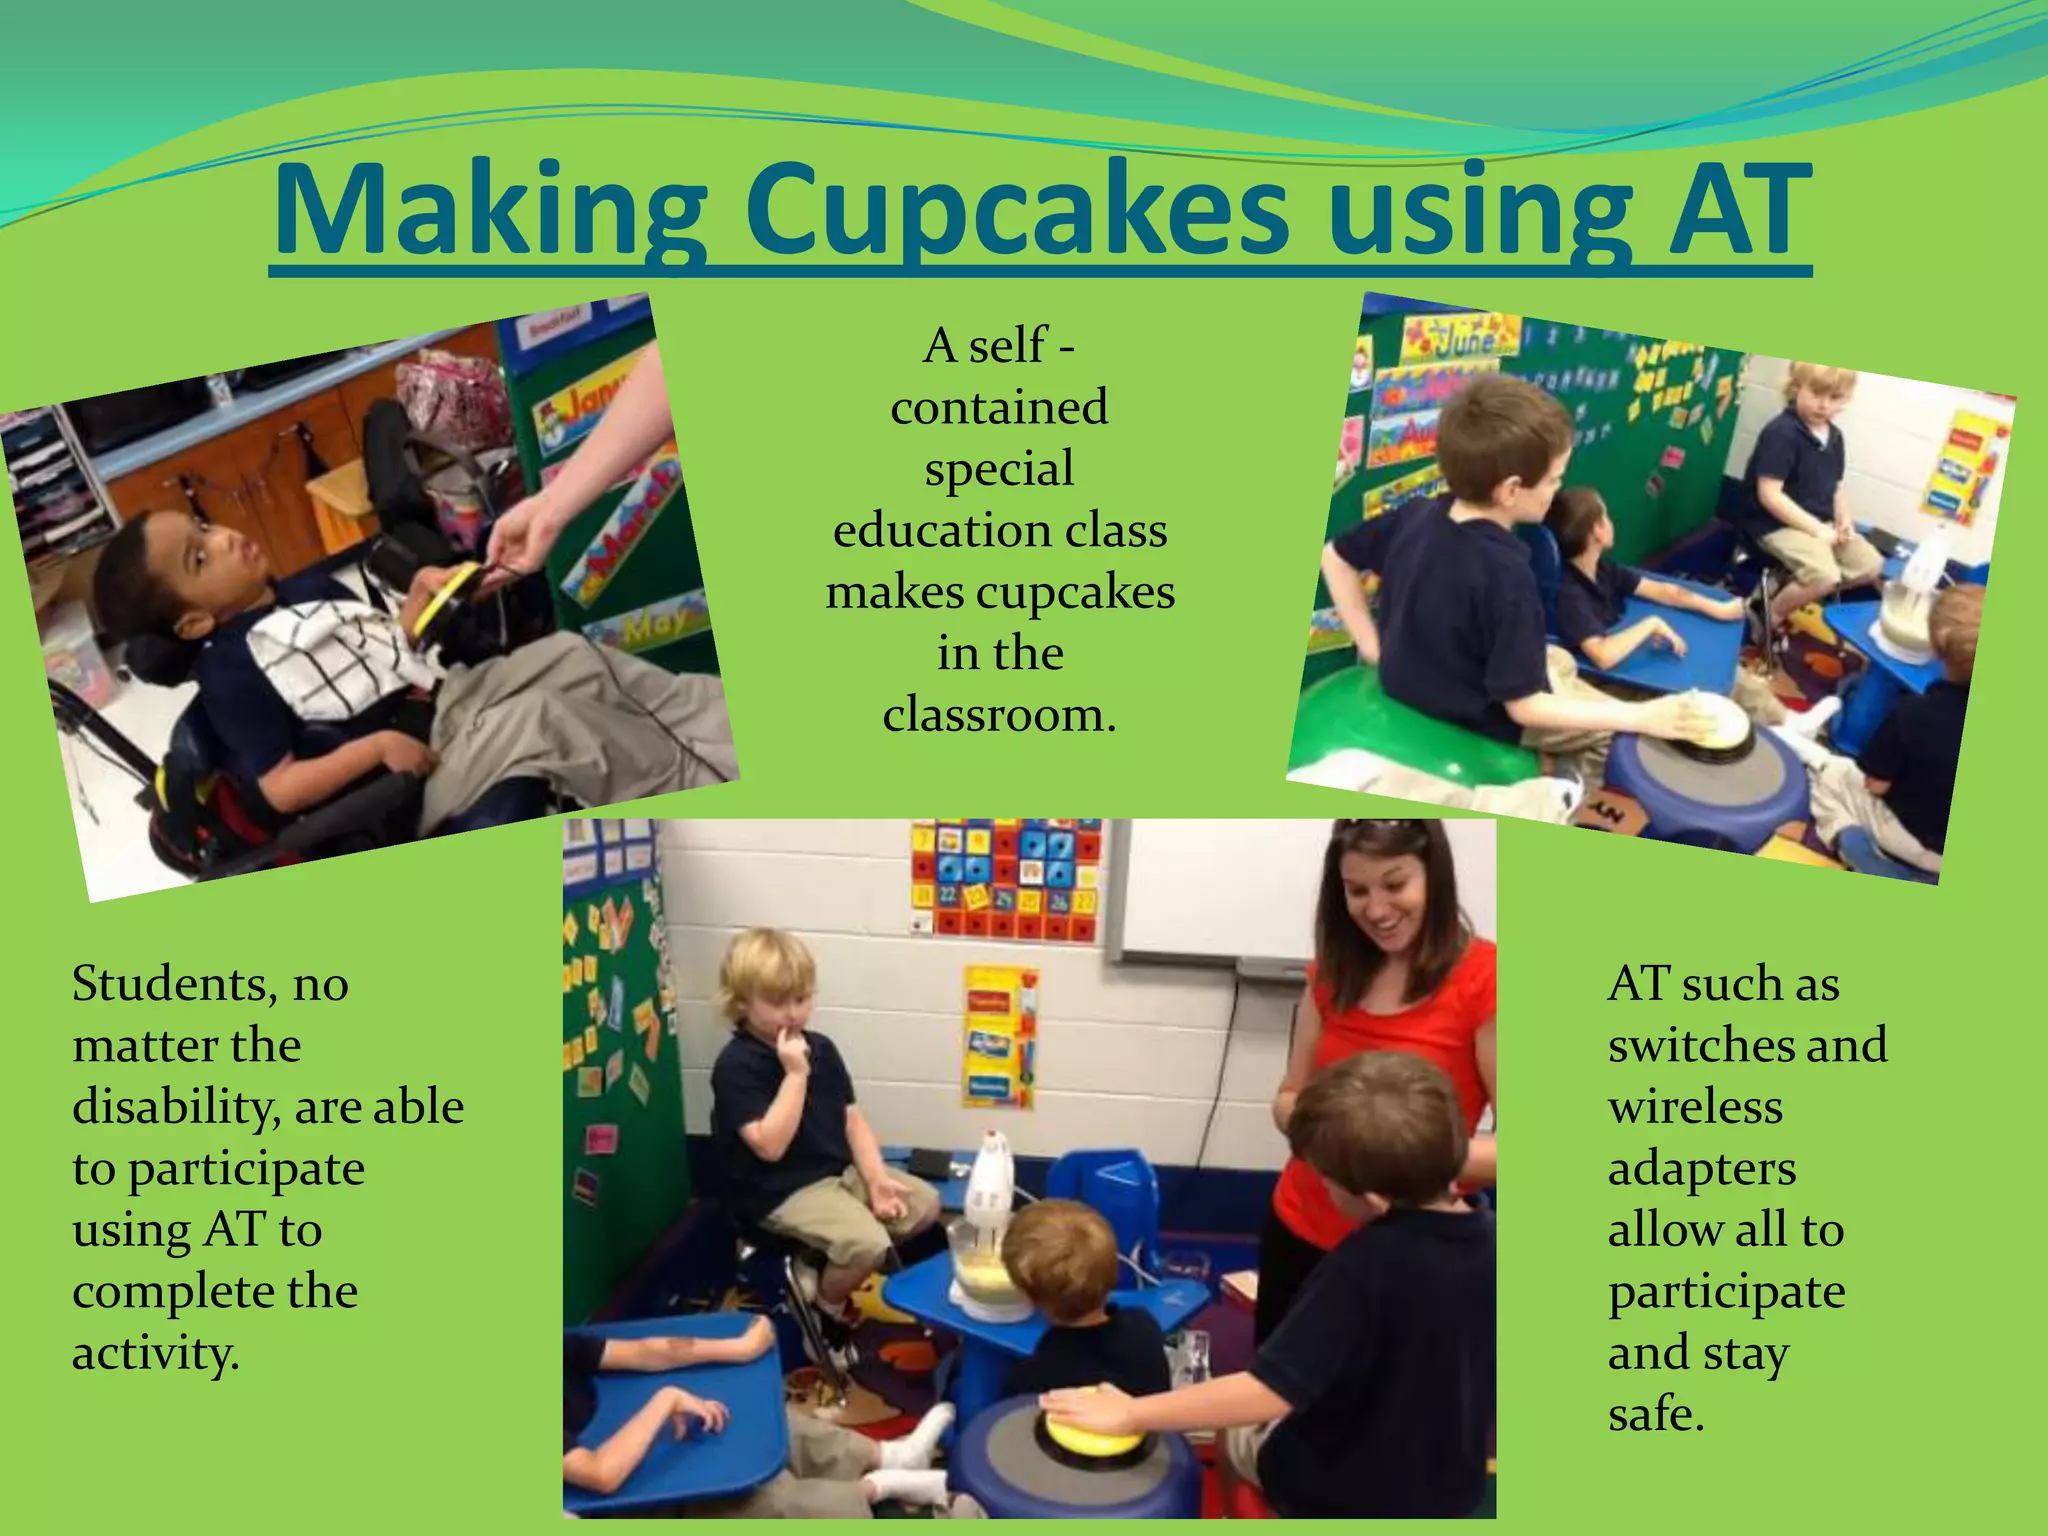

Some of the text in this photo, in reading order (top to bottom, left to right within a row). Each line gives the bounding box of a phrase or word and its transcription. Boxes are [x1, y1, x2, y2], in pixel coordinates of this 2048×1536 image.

[1436, 322, 1495, 357] June
[586, 465, 672, 579] March
[624, 606, 688, 643] May
